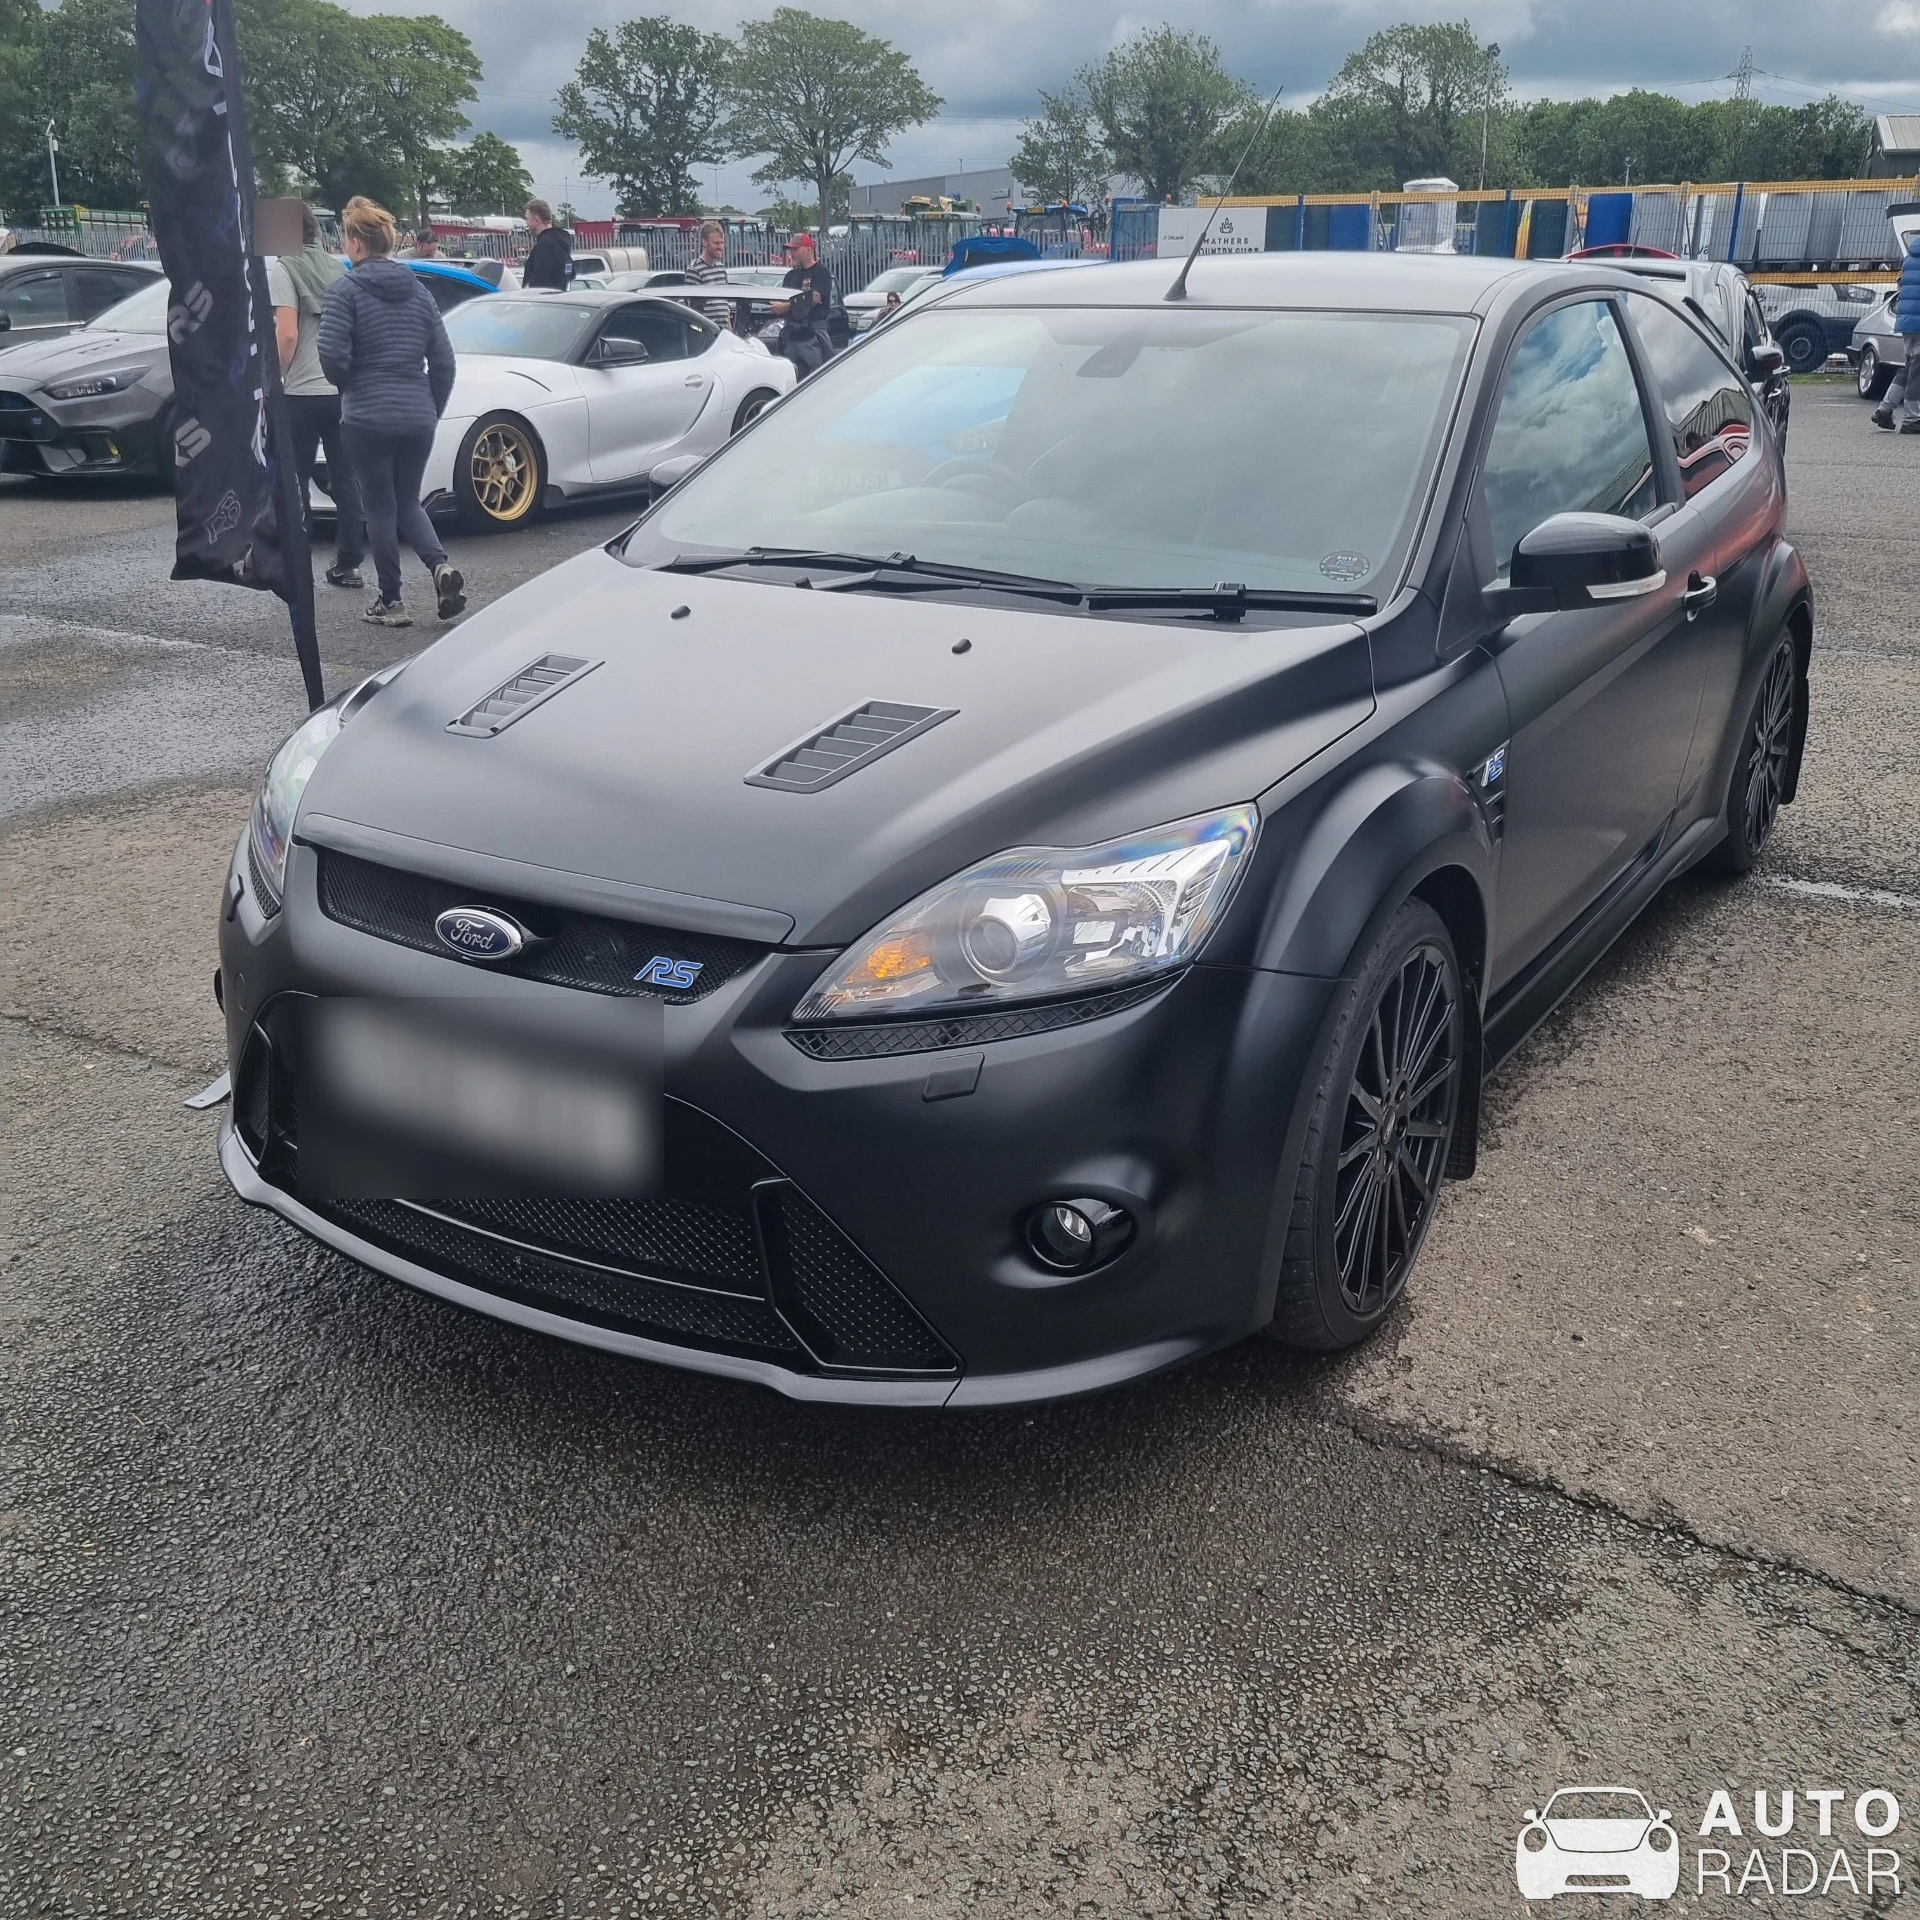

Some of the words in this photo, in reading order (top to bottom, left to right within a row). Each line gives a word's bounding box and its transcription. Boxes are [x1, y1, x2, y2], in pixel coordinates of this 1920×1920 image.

[856, 472, 888, 491] JSH
[1481, 749, 1504, 788] RS
[450, 918, 496, 951] Ford
[634, 955, 704, 989] RS
